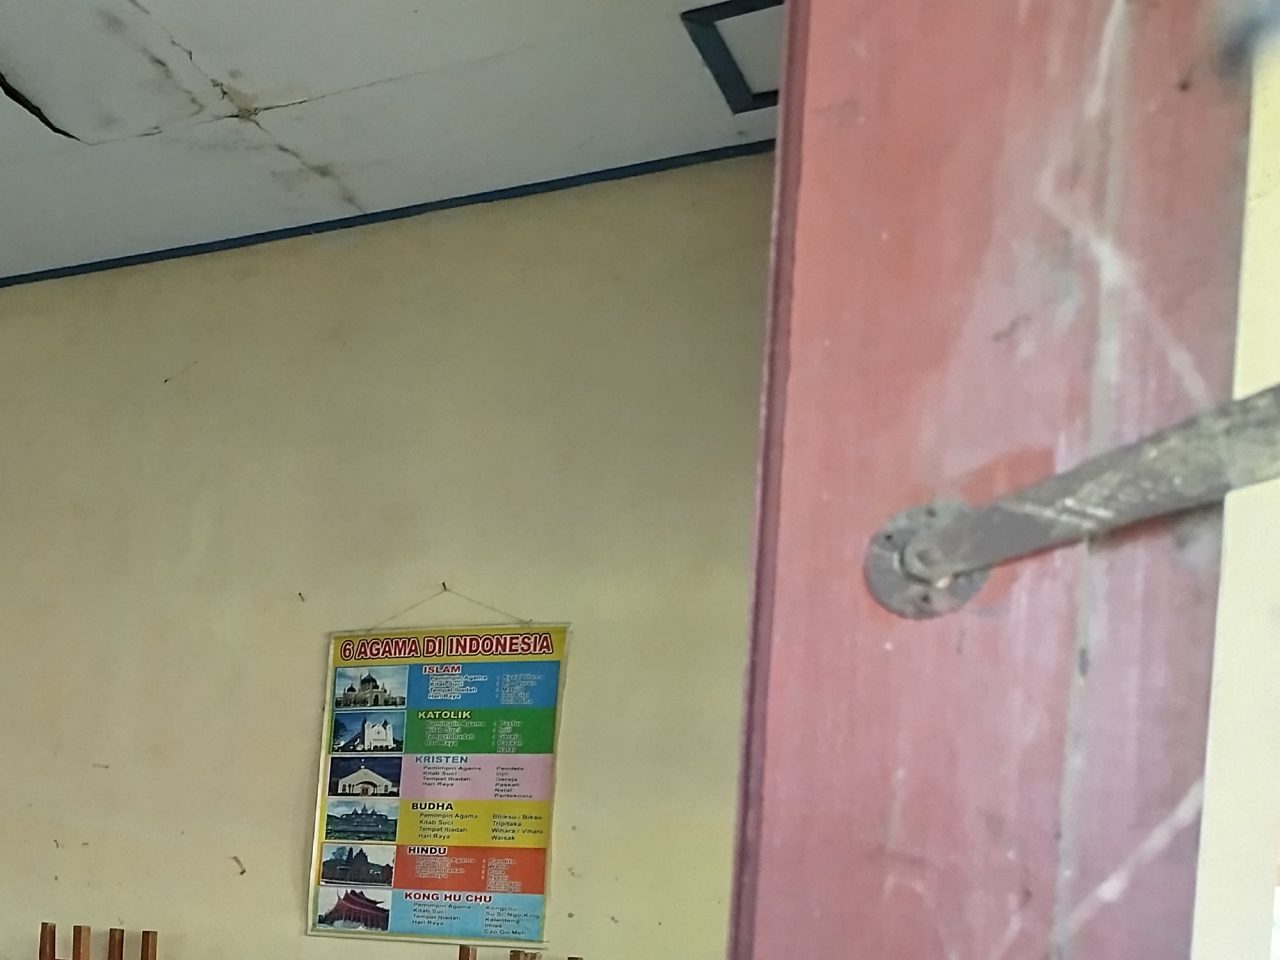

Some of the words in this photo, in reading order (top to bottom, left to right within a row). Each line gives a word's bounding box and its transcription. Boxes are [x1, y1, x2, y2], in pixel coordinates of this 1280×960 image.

[341, 640, 354, 660] 6
[356, 637, 419, 660] AGAMA
[423, 636, 445, 657] DI
[447, 633, 552, 656] INDONESIA
[423, 665, 461, 674] ISLAM
[418, 710, 471, 719] KATOLIK
[415, 756, 468, 764] KRISTEN
[411, 802, 454, 811] BUDHA
[408, 846, 447, 855] HINDU
[404, 892, 439, 901] KONG
[443, 894, 461, 902] HU
[465, 894, 492, 903] CHU
